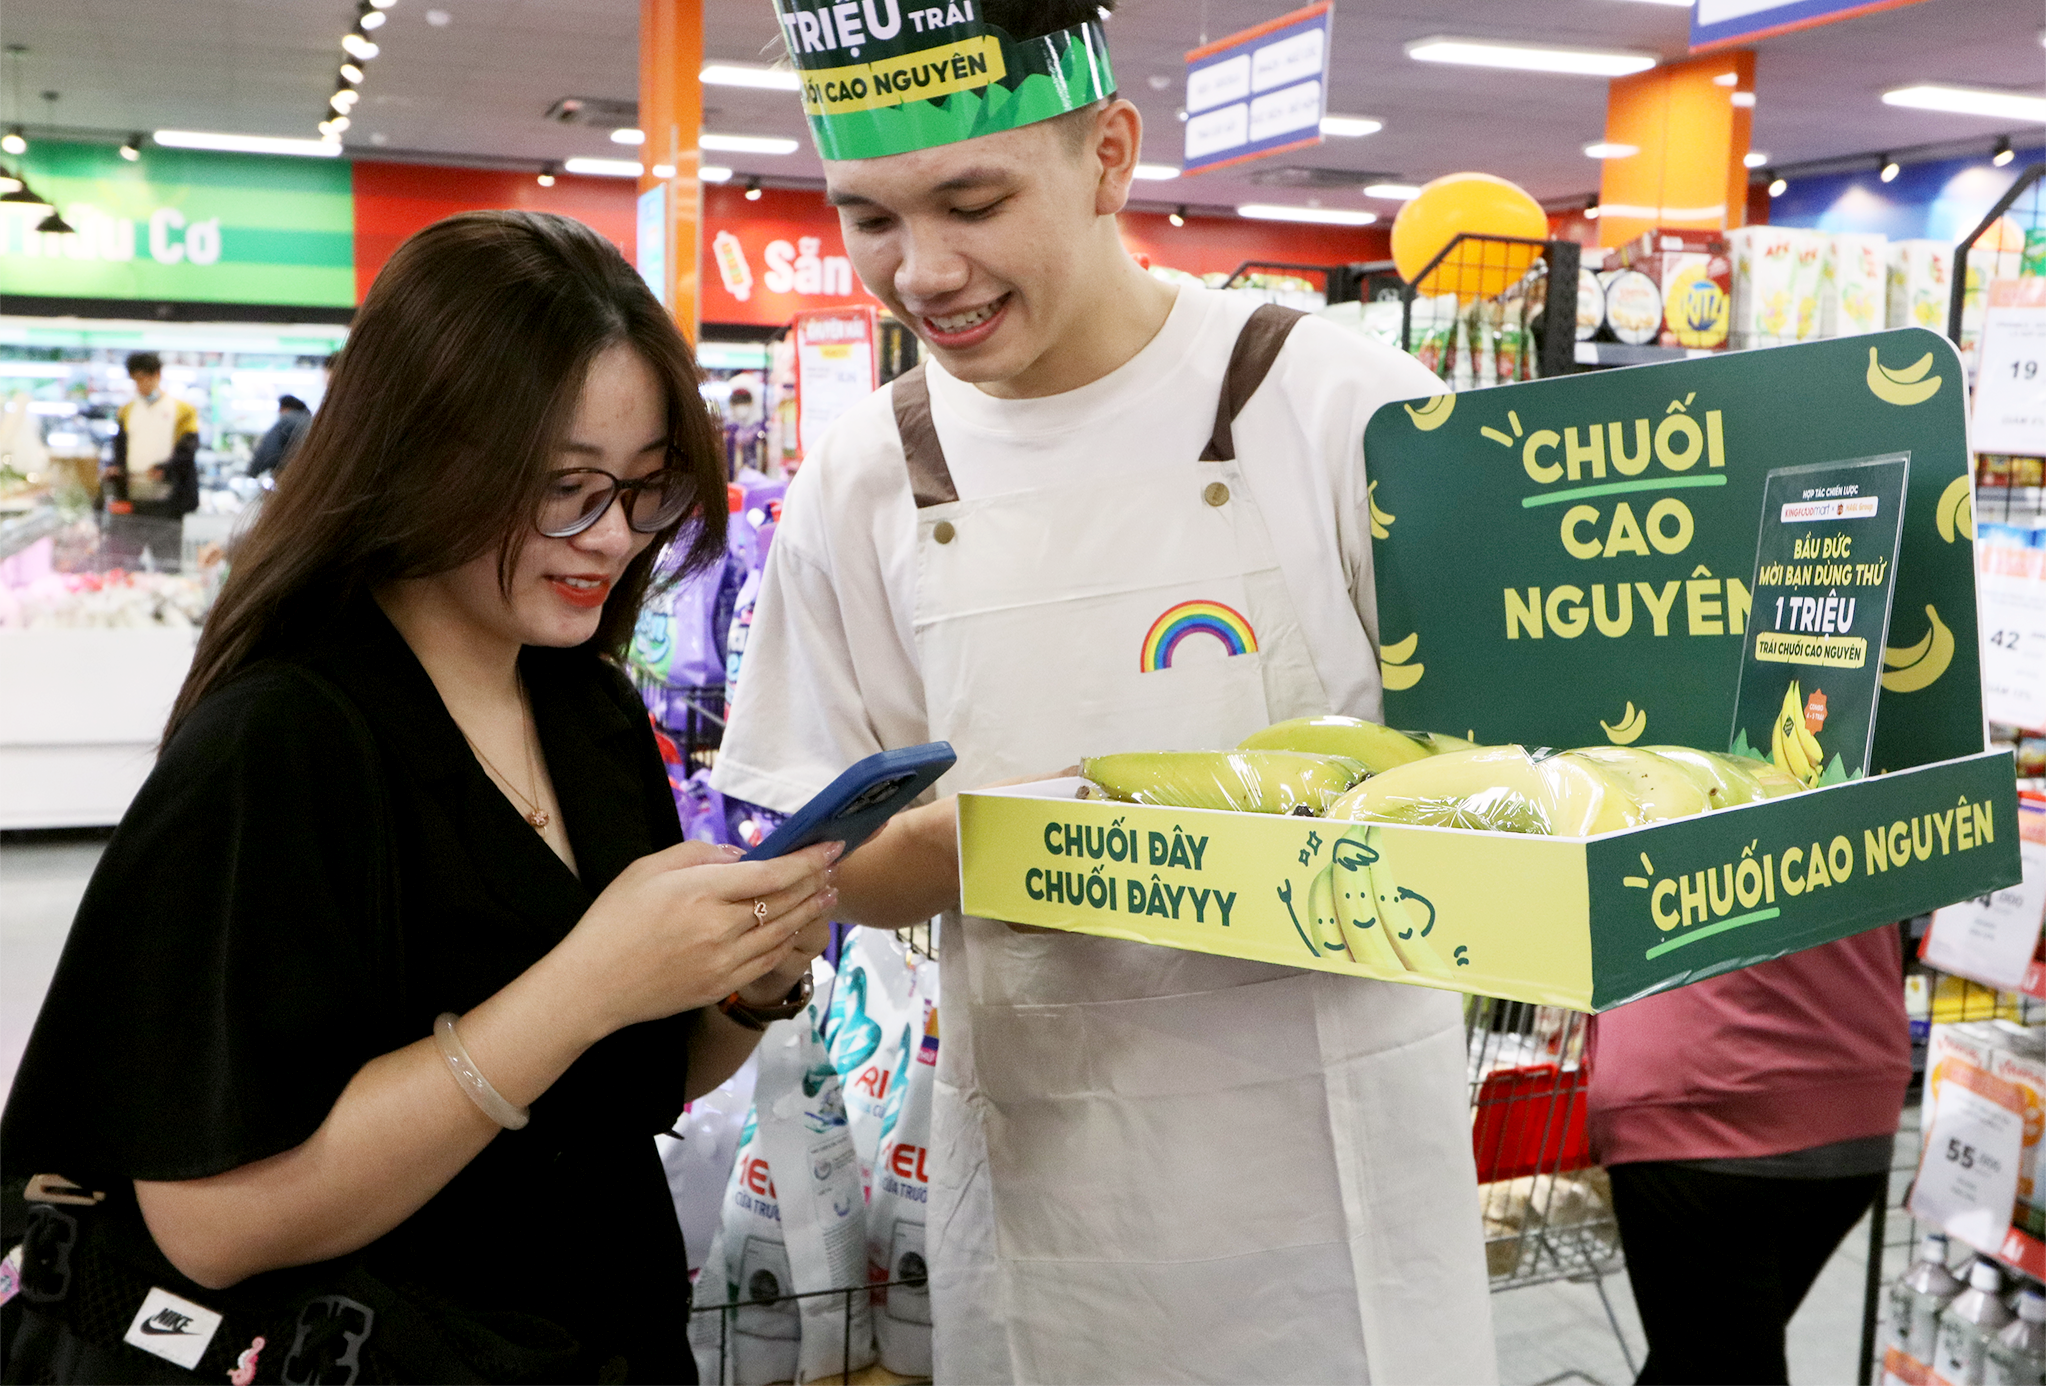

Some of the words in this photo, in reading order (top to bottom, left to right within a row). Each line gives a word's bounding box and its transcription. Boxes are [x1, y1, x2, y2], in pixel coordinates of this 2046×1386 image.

[824, 77, 868, 103] CAO
[873, 52, 988, 96] NGUYÊN
[2009, 360, 2039, 381] 19
[1522, 392, 1726, 484] CHUỐI
[1560, 497, 1695, 560] CAO
[1793, 531, 1821, 560] BẦU
[1822, 531, 1852, 559] ĐỨC
[1759, 561, 1784, 586] MỜI
[1785, 565, 1813, 591] BẠN
[1813, 559, 1853, 587] DÙNG
[1855, 556, 1888, 586] THỬ
[1775, 596, 1785, 630] 1
[1789, 588, 1856, 642] TRIỆU
[1760, 638, 1777, 654] TRÁI
[1778, 640, 1804, 657] CHUỐI
[1804, 644, 1823, 658] CAO
[1823, 645, 1862, 661] NGUYÊN
[1044, 816, 1138, 864] CHUỐI
[1148, 824, 1210, 871] ĐÂY
[1651, 838, 1776, 931] CHUỐI
[1780, 834, 1854, 896] CAO
[1864, 795, 1995, 876] NGUYÊN
[1025, 864, 1118, 911] CHUỐI
[1127, 873, 1238, 927] ĐÂYYY
[1946, 1137, 1976, 1169] 55
